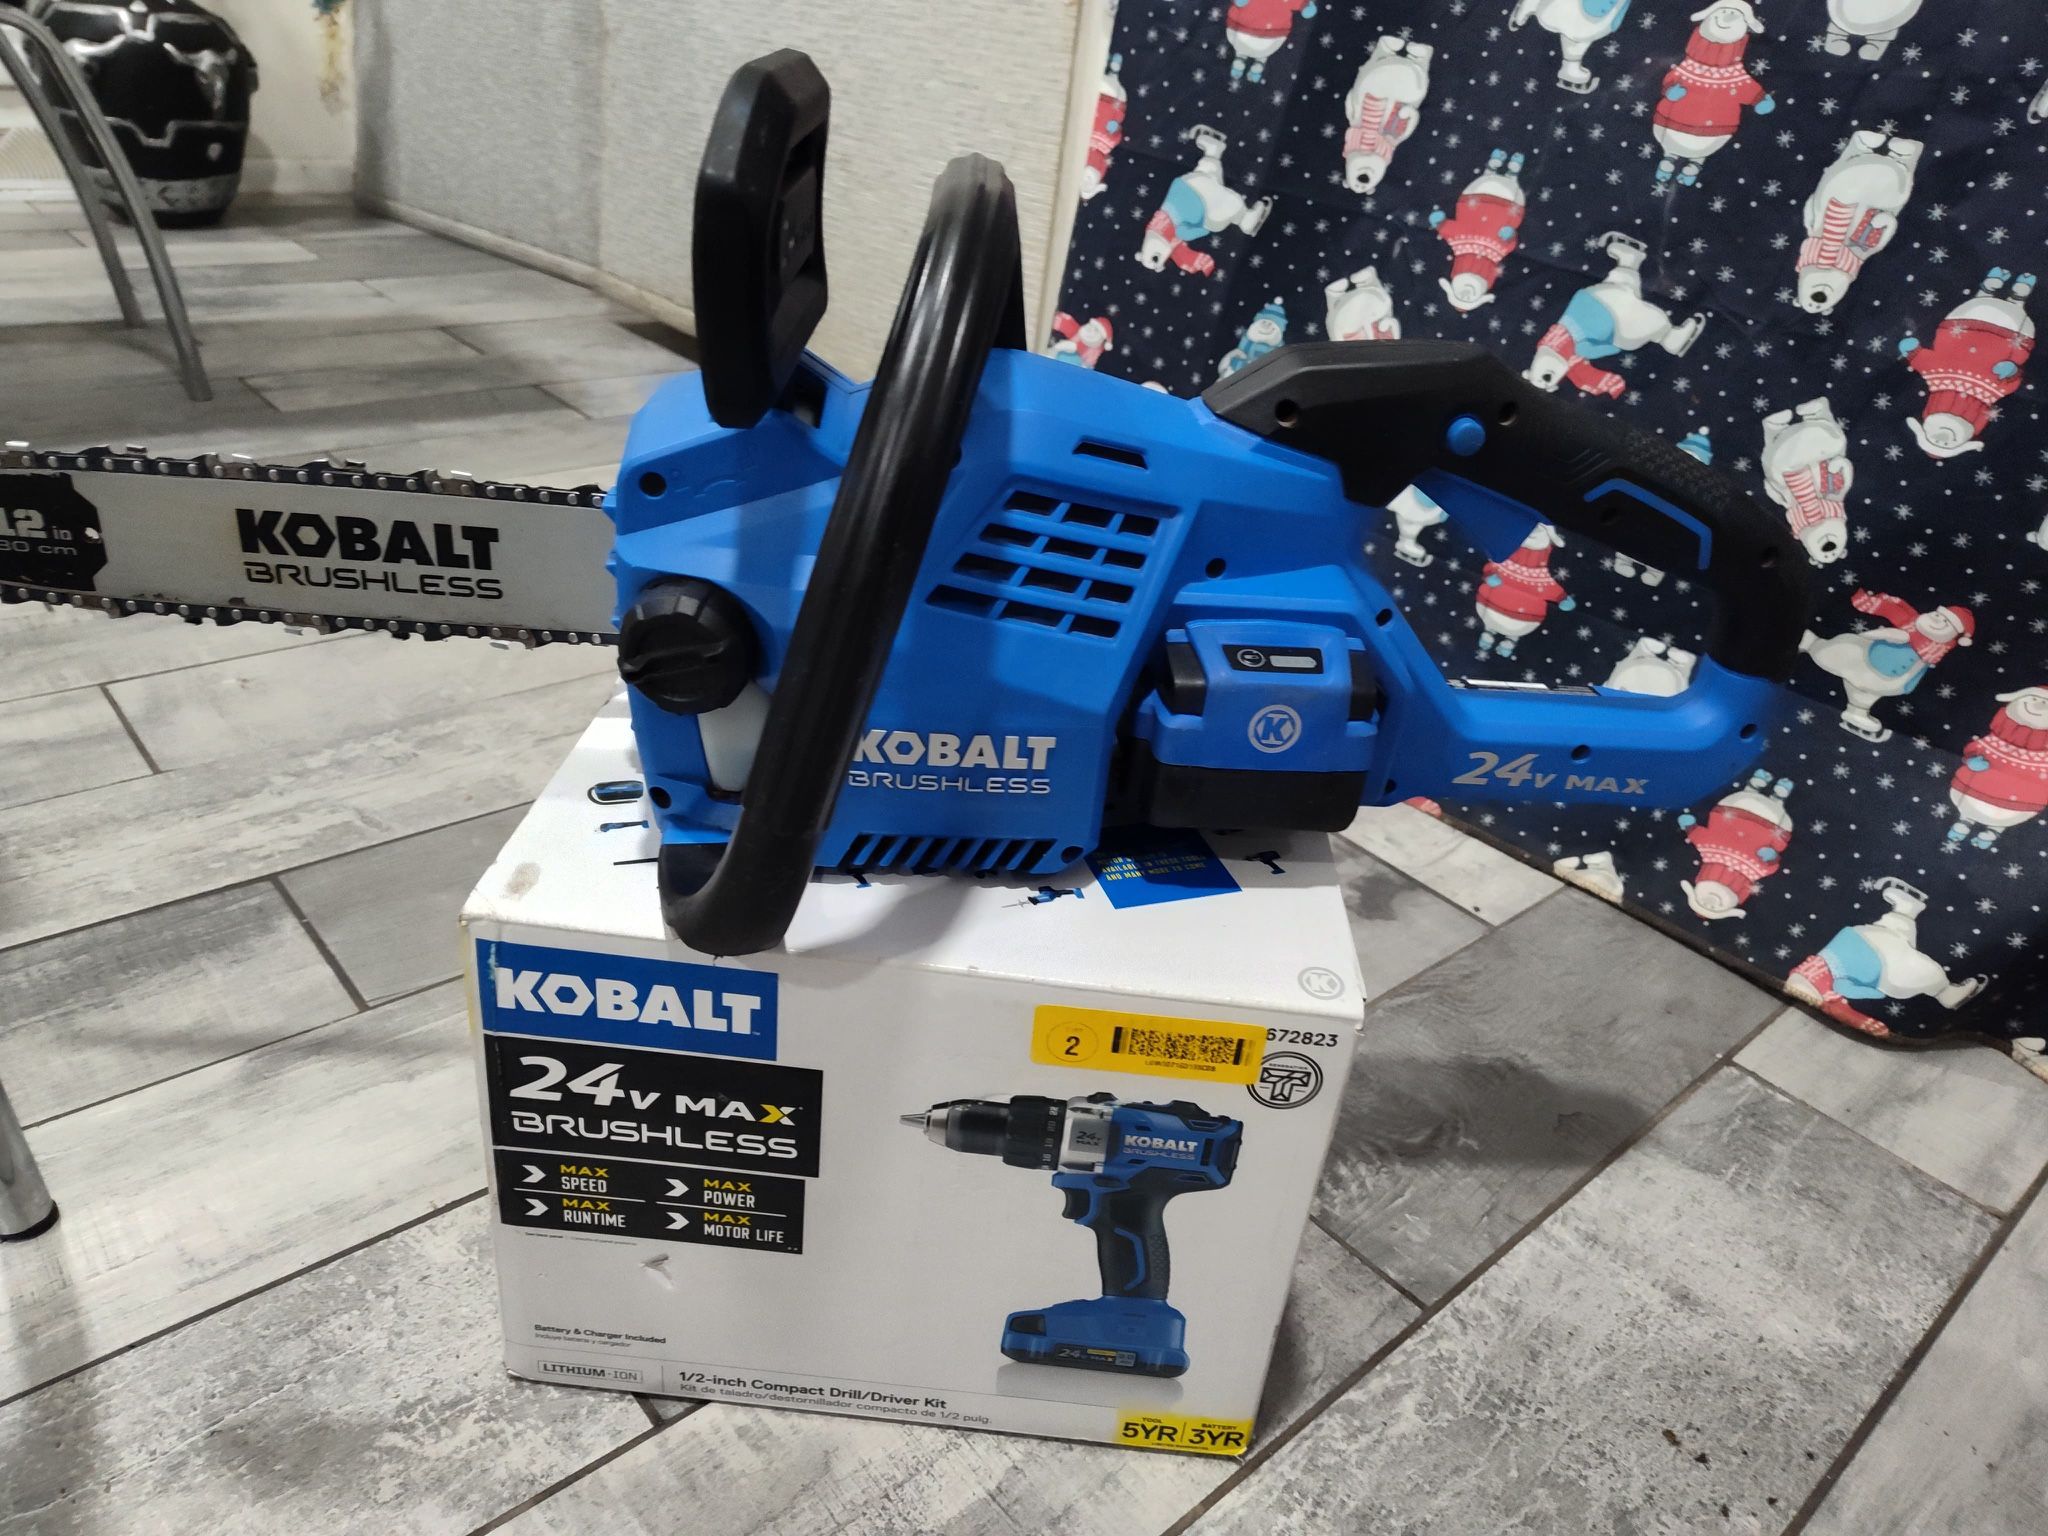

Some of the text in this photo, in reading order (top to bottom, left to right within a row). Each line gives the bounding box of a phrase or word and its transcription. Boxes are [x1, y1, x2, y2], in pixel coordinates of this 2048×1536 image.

[52, 525, 72, 540] in
[235, 509, 499, 570] KOBALT
[38, 545, 77, 556] cm
[243, 561, 503, 599] BRUSHLESS
[853, 729, 1057, 770] KOBALT
[848, 770, 1051, 794] BRUSHLESS
[1566, 775, 1650, 796] MAX
[1124, 871, 1145, 879] MAN
[495, 967, 761, 1034] KOBALT
[1065, 1036, 1081, 1056] 2
[1266, 1028, 1338, 1047] 672823
[675, 1095, 796, 1126] MAX
[511, 1111, 798, 1159] BRUSHLESS
[1124, 1135, 1198, 1152] KOBALT
[1123, 1147, 1195, 1161] BRUSHLESS
[560, 1164, 609, 1178] MAX
[561, 1176, 607, 1193] SPEED
[703, 1178, 752, 1192] MAX
[562, 1198, 611, 1212] MAX
[704, 1190, 755, 1209] POWER
[563, 1210, 626, 1228] RUNTIME
[704, 1212, 751, 1226] MAX
[704, 1223, 784, 1244] MOTOR LIFE
[534, 1324, 571, 1335] Battery
[584, 1329, 622, 1339] Charger
[625, 1333, 666, 1344] Included
[679, 1371, 947, 1409] 1/2-inch Compact Drill/Driver Kit
[680, 1384, 697, 1392] Kit
[701, 1386, 716, 1394] de
[720, 1388, 852, 1408] taladro/destornillador
[856, 1402, 917, 1416] compacto
[921, 1409, 936, 1417] de
[940, 1411, 960, 1420] 1/2
[1122, 1422, 1178, 1442] 5YR
[1188, 1428, 1245, 1447] 3YR
